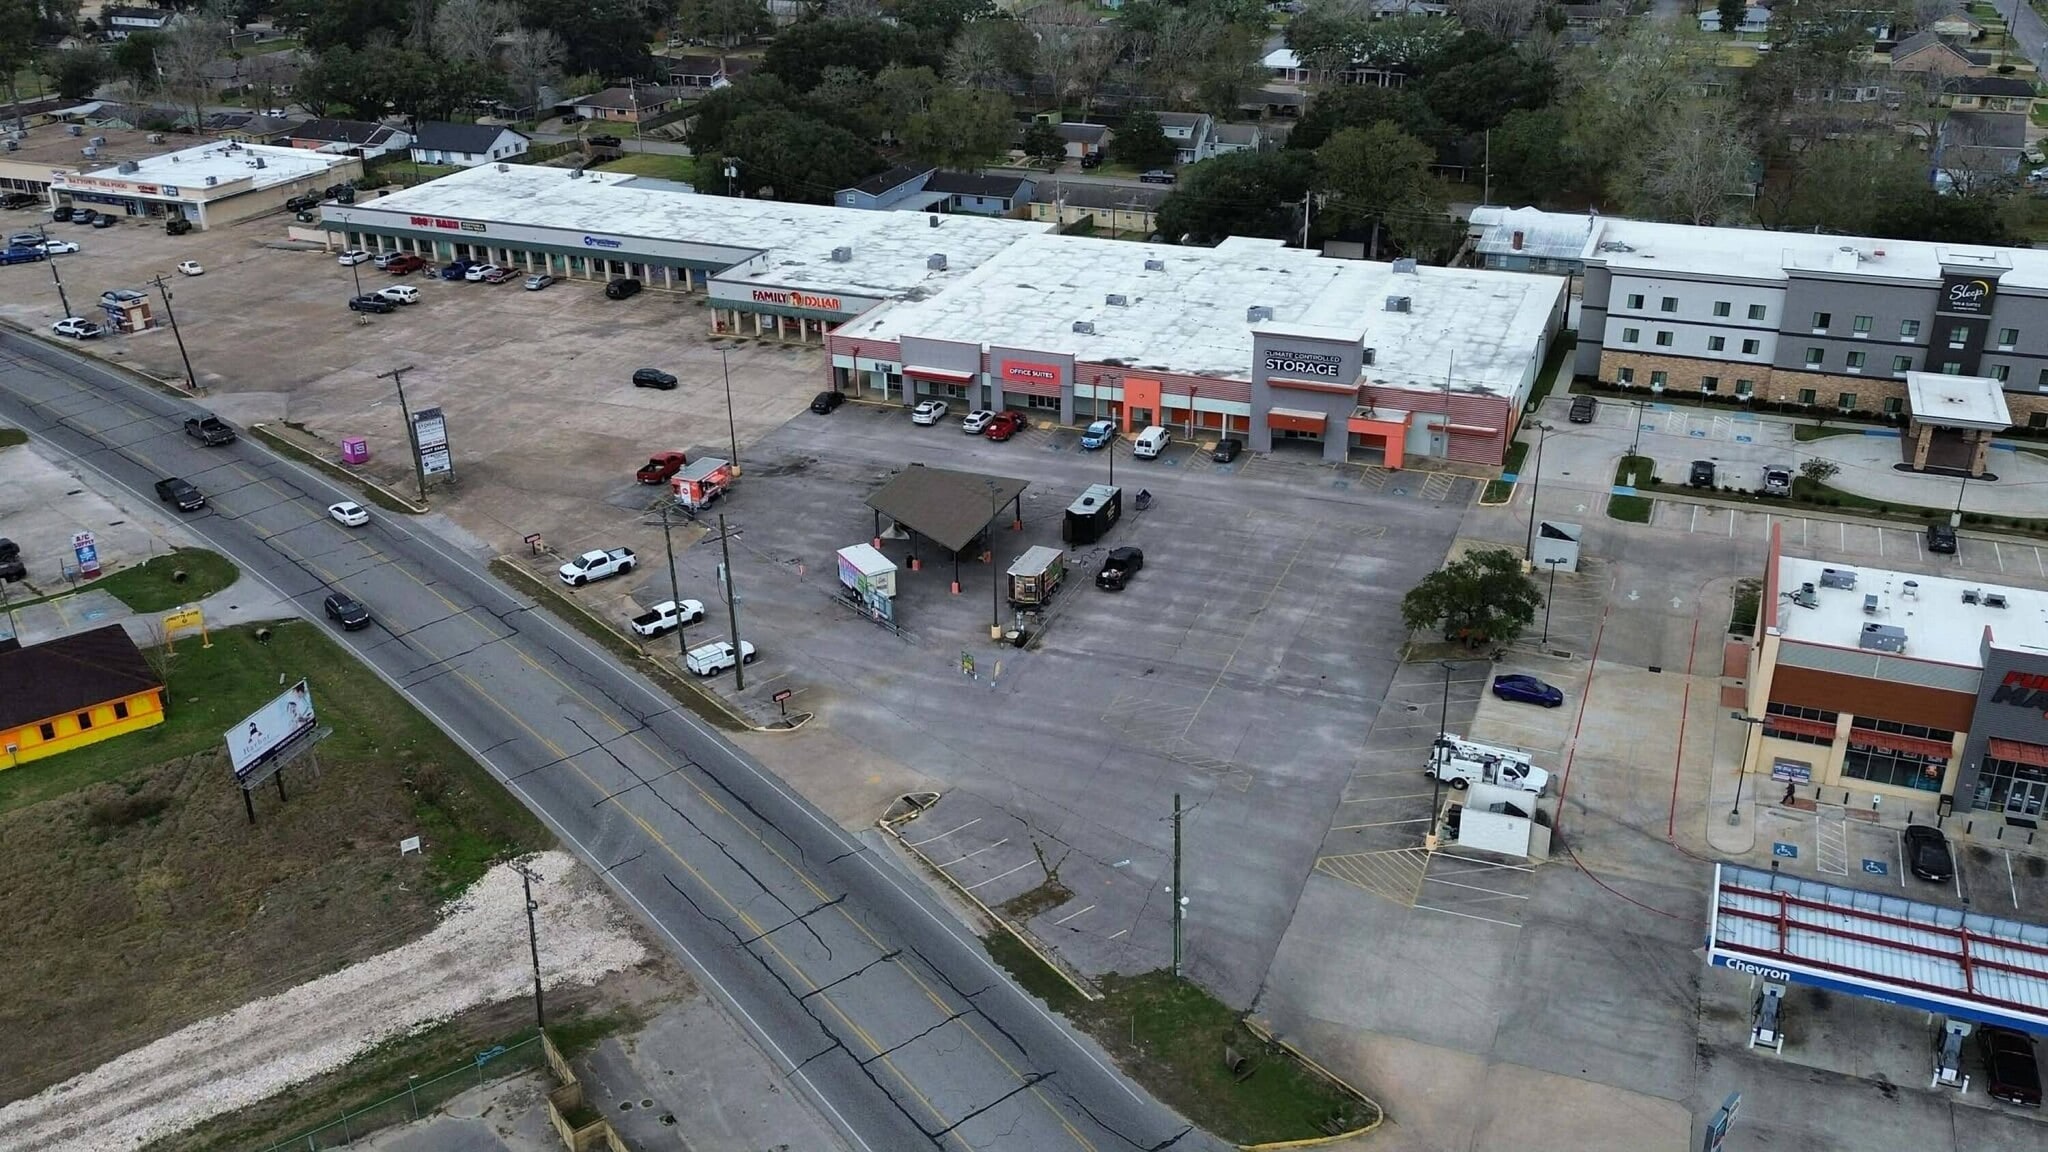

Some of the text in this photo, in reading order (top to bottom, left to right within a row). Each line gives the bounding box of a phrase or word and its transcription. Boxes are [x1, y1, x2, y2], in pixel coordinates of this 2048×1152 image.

[752, 290, 840, 310] FAMILY DOLLAR
[1949, 284, 1984, 301] Sleep
[1264, 350, 1340, 363] CLIMATE CONTROLLED
[1009, 368, 1054, 379] OFFICE SUITES
[1265, 358, 1338, 376] STORAGE
[1725, 957, 1791, 982] Chevron
